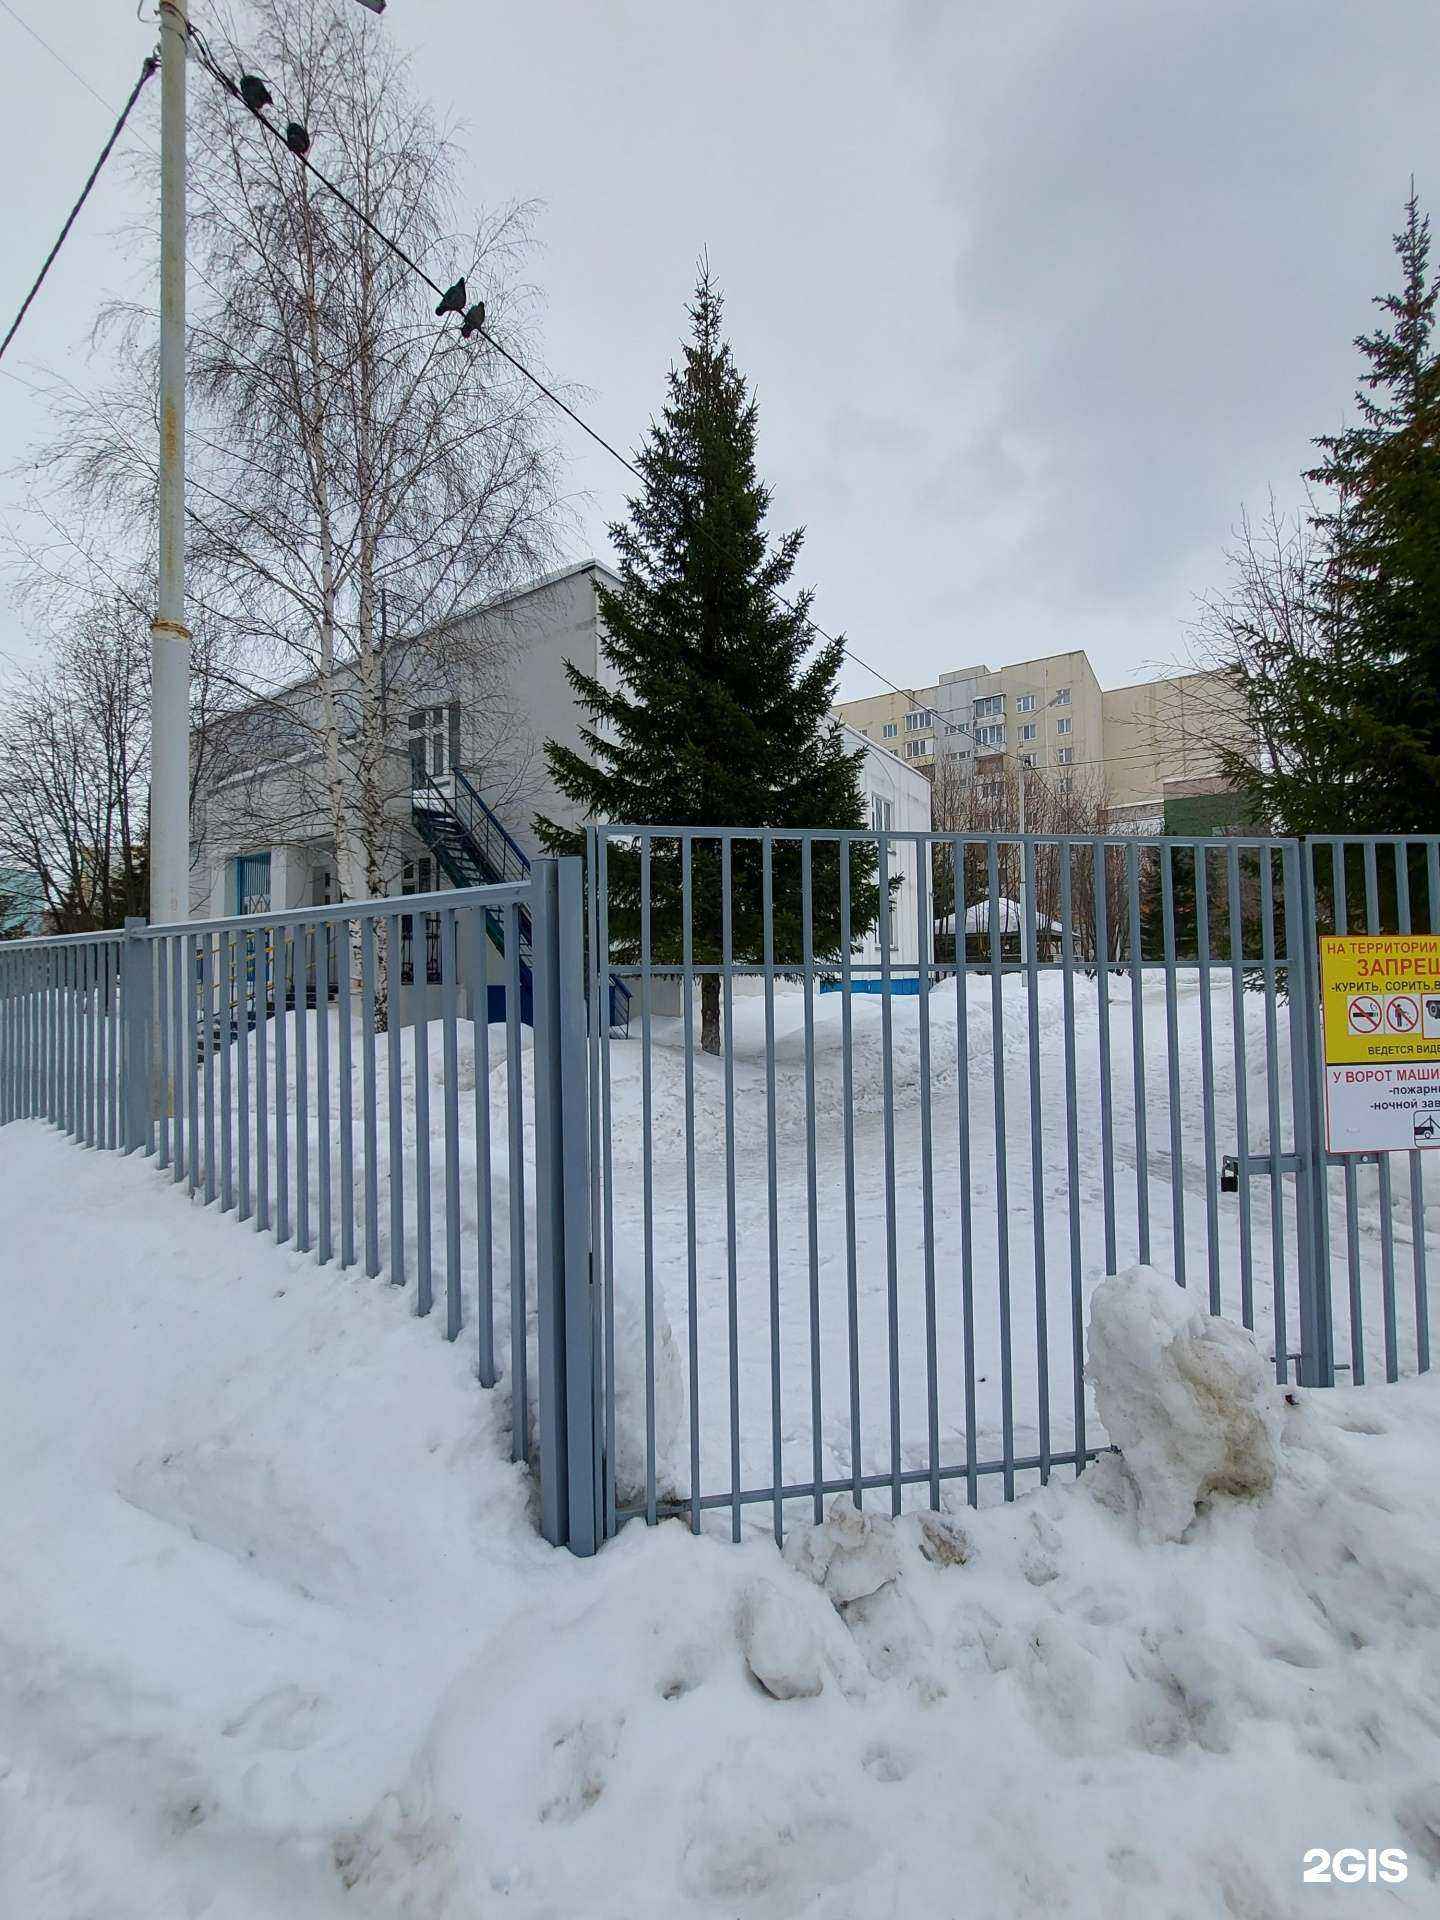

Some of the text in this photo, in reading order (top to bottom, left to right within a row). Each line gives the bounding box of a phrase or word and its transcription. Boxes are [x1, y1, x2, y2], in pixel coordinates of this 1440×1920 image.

[1327, 942, 1437, 954] НА ТЕРРИТОРИИ
[1368, 1045, 1413, 1056] ВЕДЕТСЯ
[1333, 1071, 1341, 1083] У
[1345, 1070, 1392, 1083] ВОРОТ
[1389, 1085, 1440, 1096] -пожарн
[1370, 1098, 1418, 1110] -ночной
